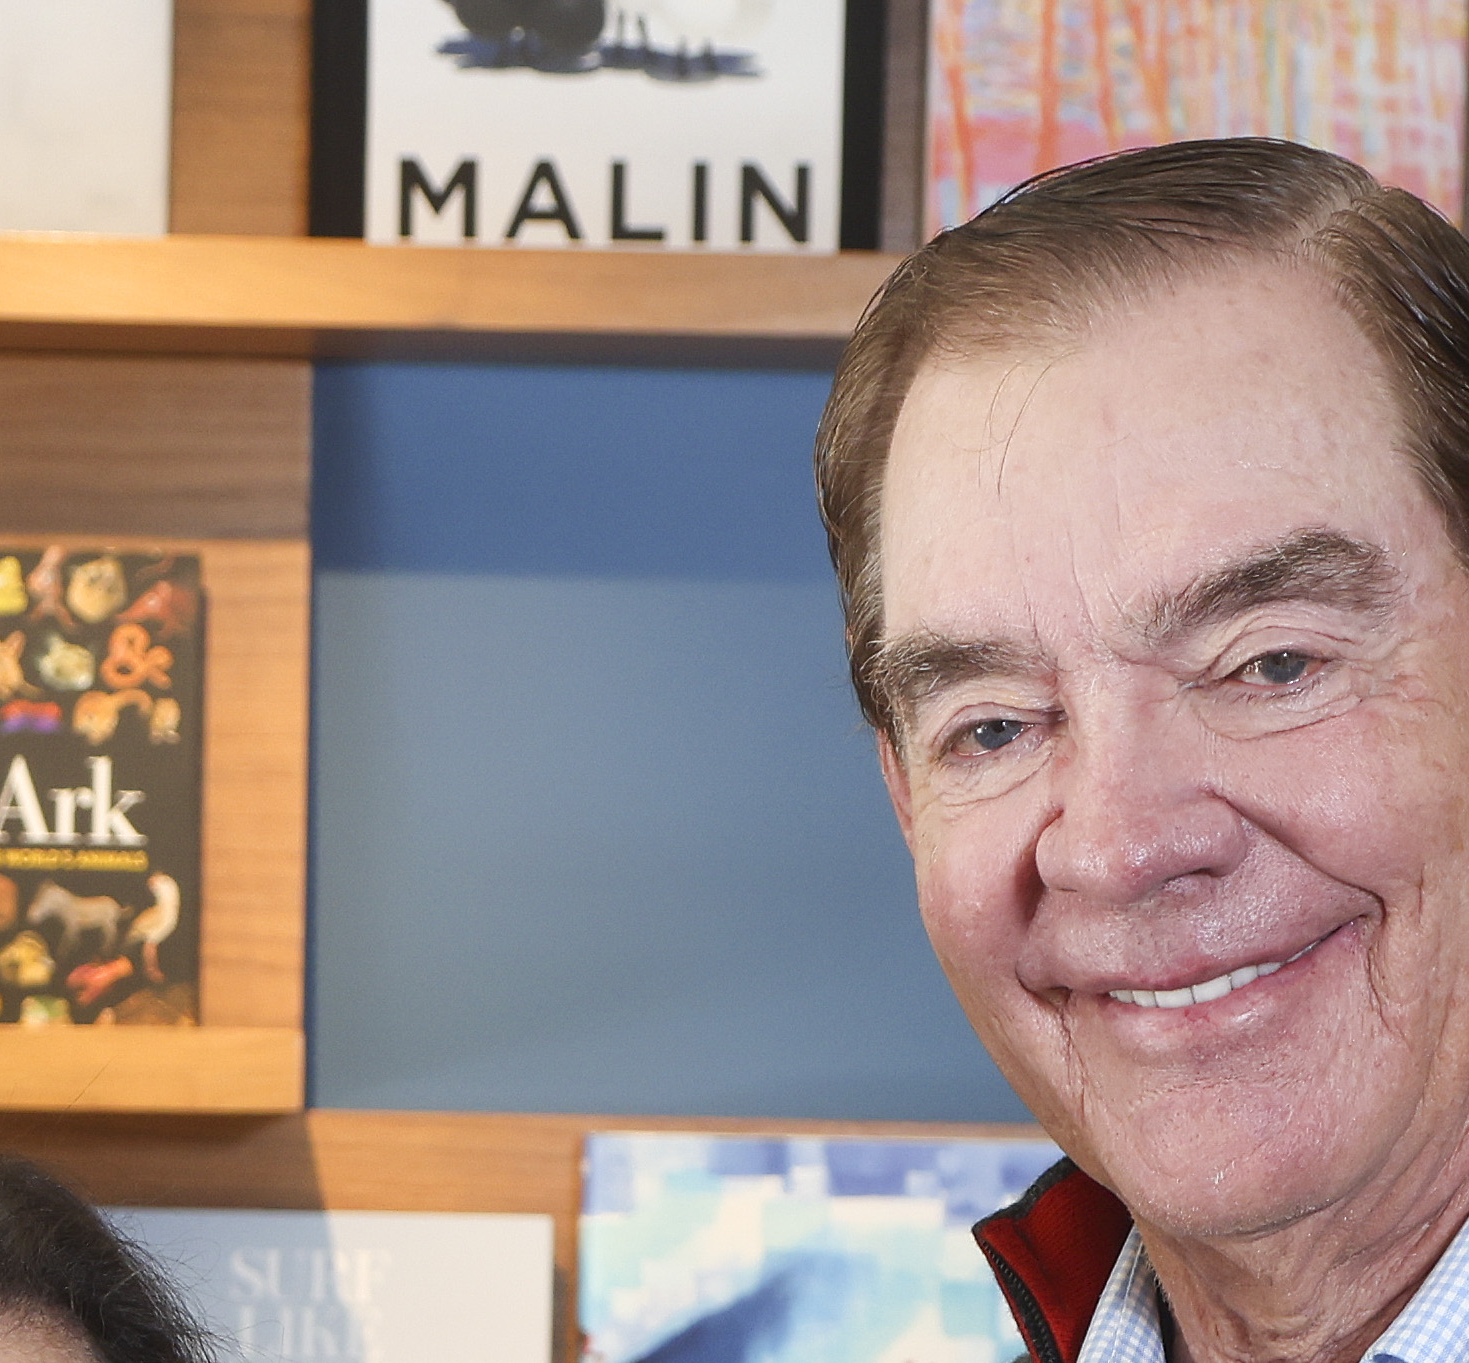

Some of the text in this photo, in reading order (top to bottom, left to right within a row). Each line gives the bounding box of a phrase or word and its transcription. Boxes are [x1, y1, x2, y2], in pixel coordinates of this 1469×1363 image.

[398, 157, 812, 243] MALIN
[230, 1247, 394, 1301] SURF
[238, 1302, 385, 1358] LIKE
